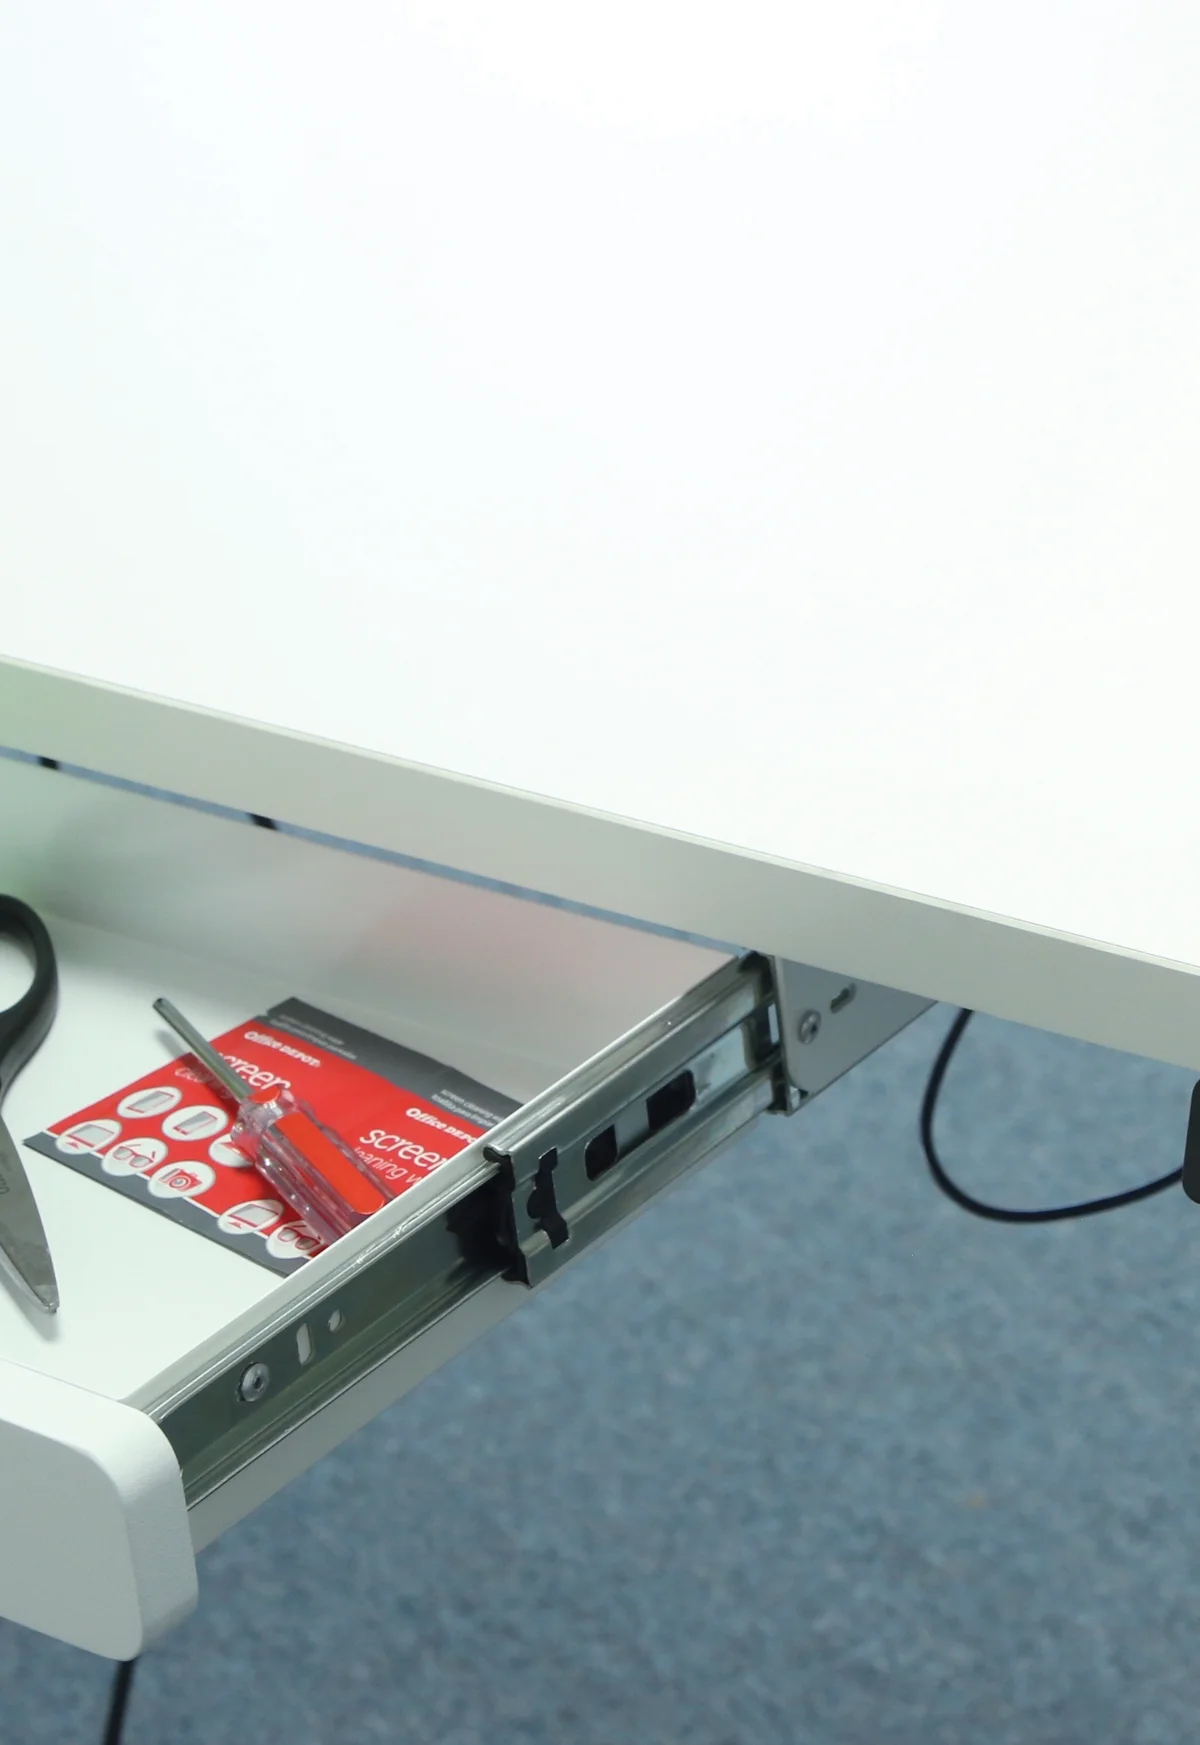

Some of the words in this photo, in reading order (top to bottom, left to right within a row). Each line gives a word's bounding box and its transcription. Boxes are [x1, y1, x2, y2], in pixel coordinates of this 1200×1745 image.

[244, 1031, 282, 1050] Office
[218, 1052, 291, 1090] creen
[406, 1107, 447, 1130] Office
